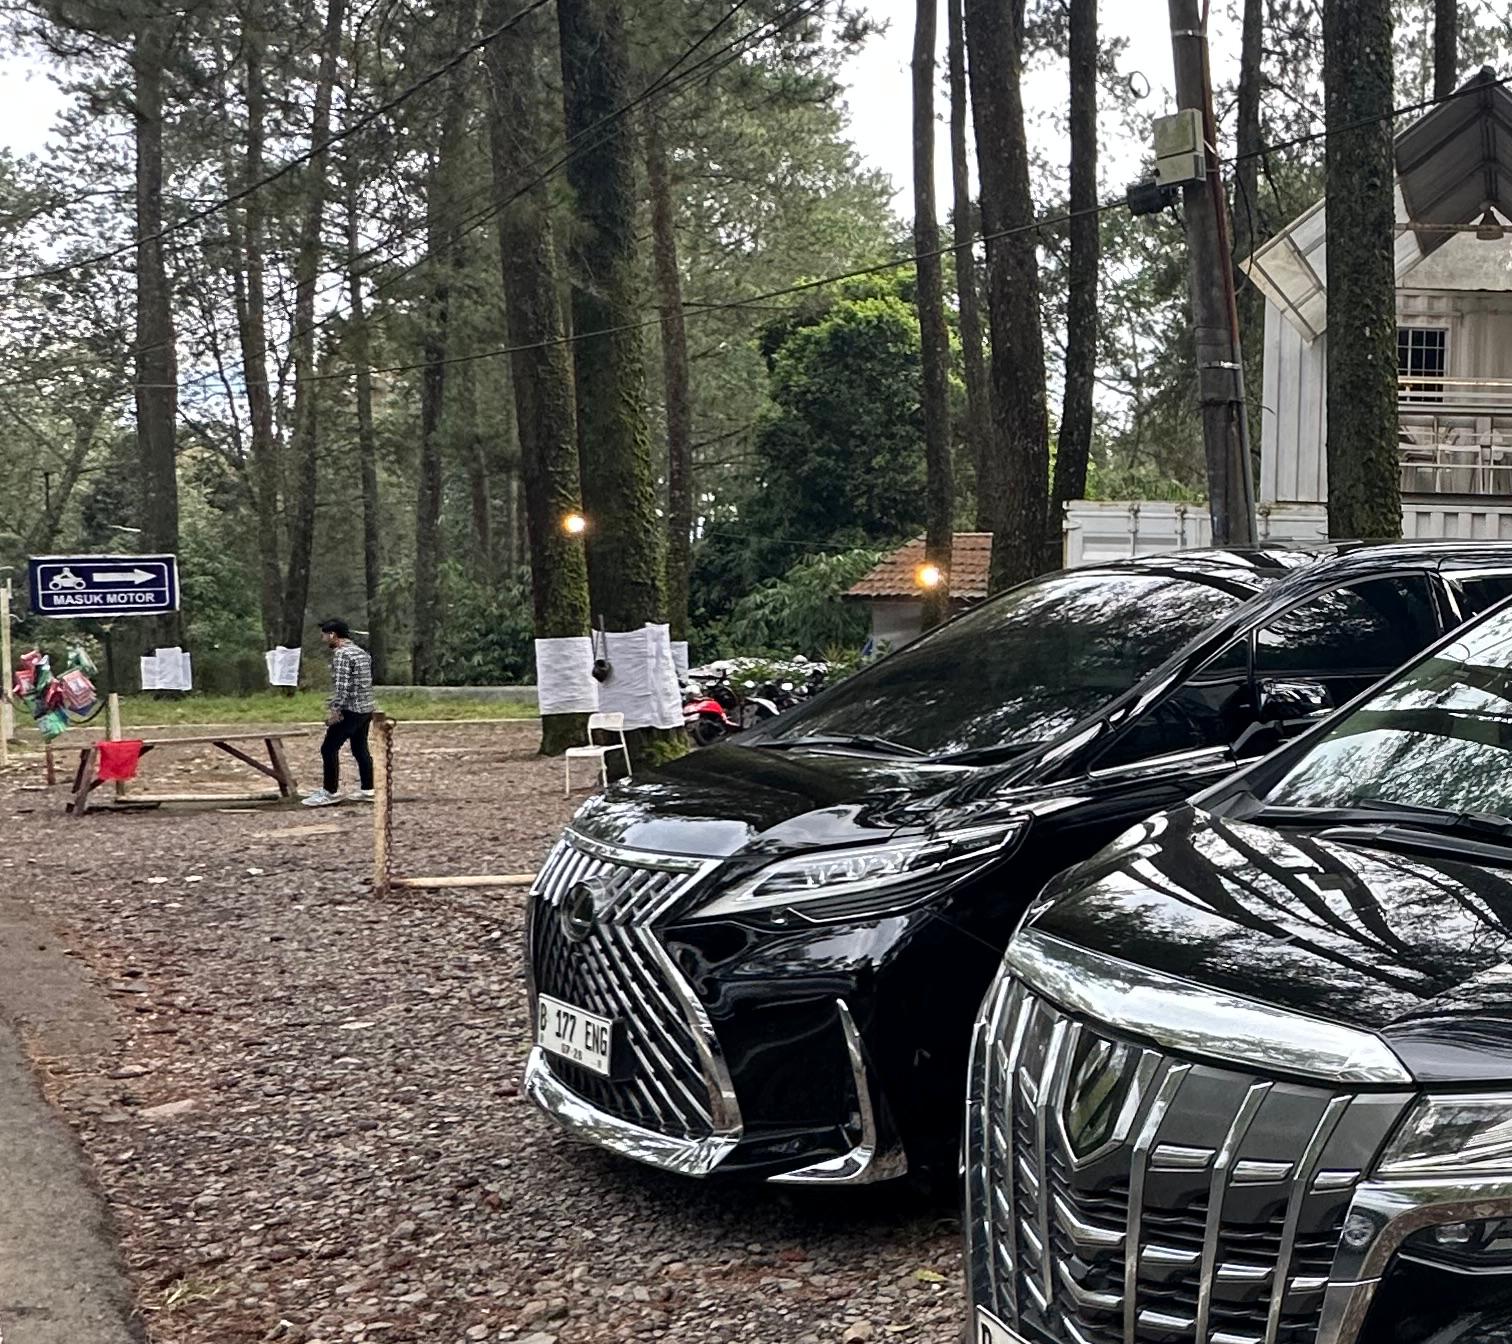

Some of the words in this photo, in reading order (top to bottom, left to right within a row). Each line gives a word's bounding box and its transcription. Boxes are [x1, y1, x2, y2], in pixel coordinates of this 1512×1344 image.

[53, 593, 103, 605] MASUK
[106, 592, 155, 604] MOTOR
[540, 1002, 547, 1031] B
[555, 1009, 577, 1044] 177
[585, 1019, 608, 1057] ENG
